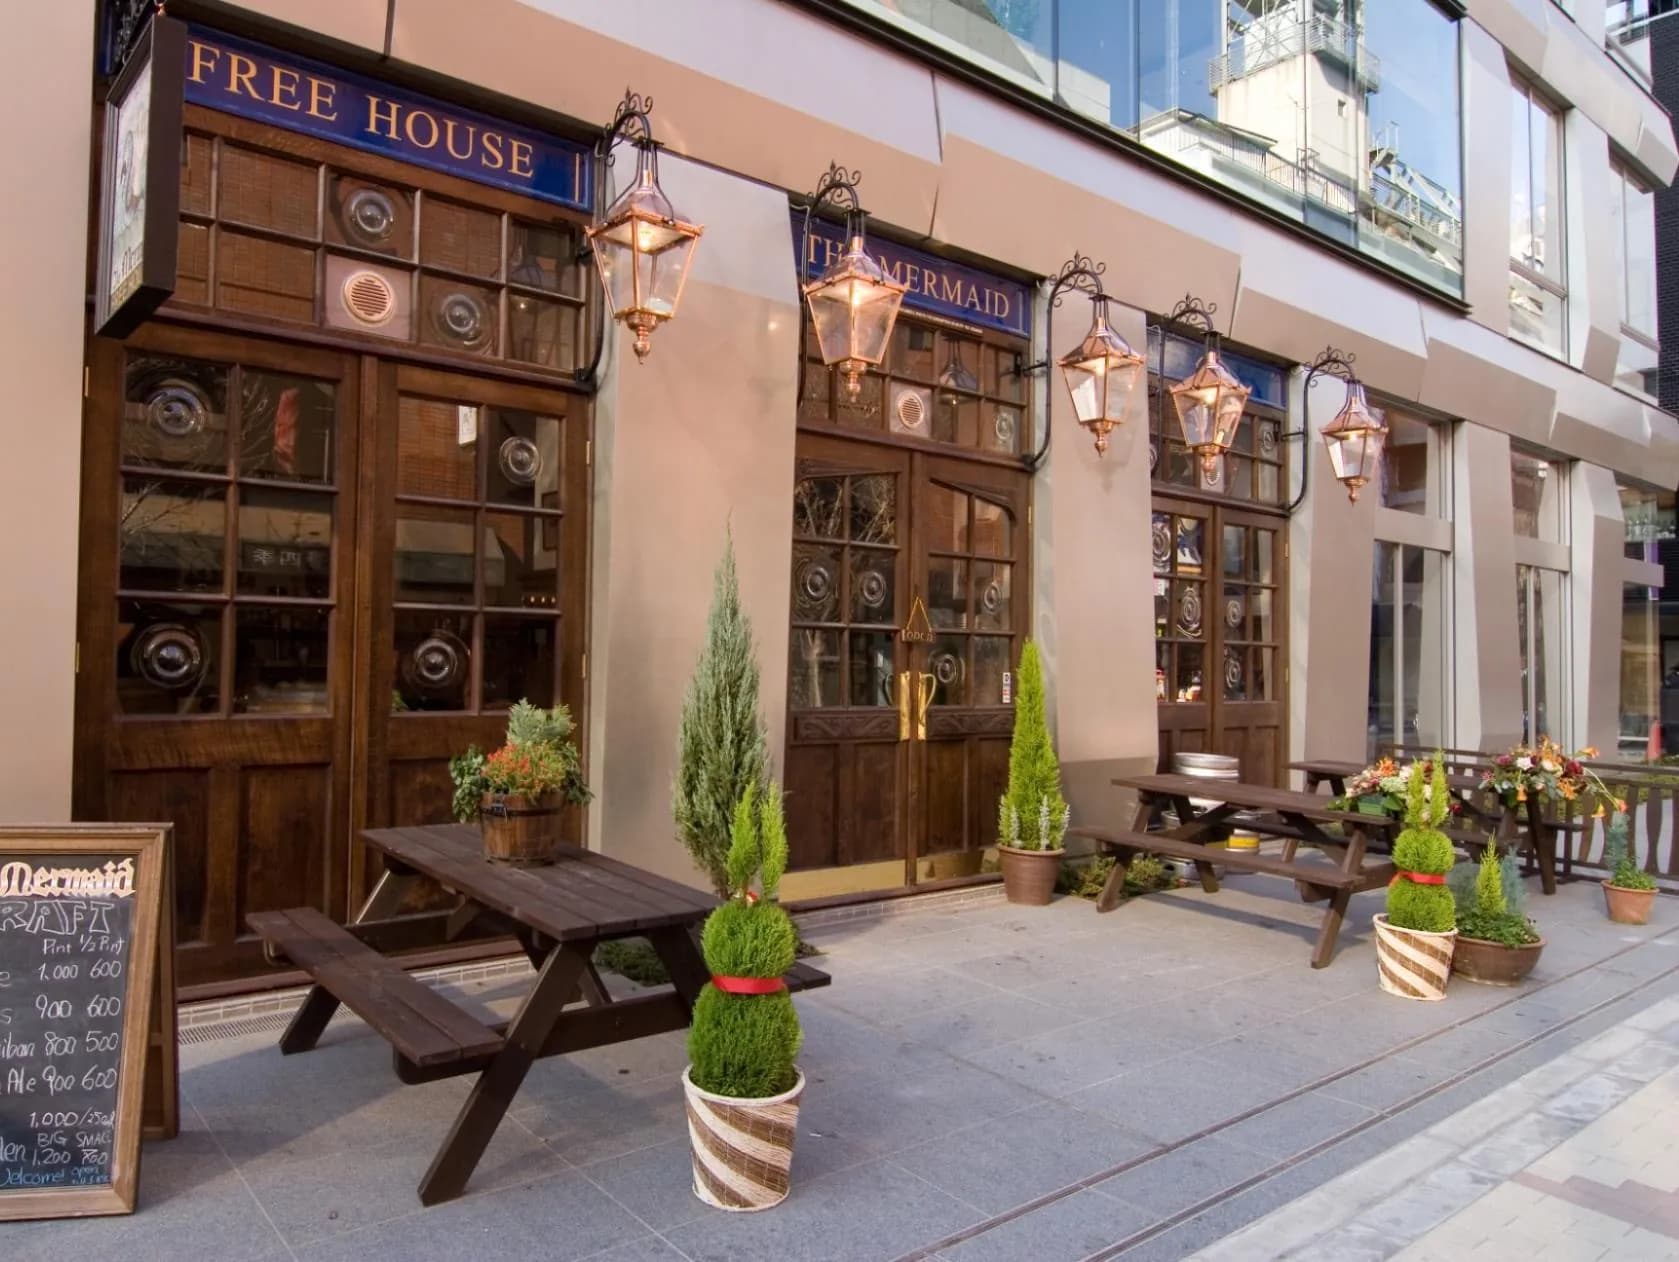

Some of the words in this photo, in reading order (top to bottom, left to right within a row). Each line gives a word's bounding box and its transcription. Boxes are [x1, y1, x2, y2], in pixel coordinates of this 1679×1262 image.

[186, 41, 337, 122] FREE
[364, 94, 534, 178] HOUSE
[808, 233, 847, 269] TH
[878, 255, 1009, 319] MERMAID
[0, 858, 136, 897] Mermaid
[42, 938, 72, 955] Pint
[90, 958, 121, 978] 600
[35, 994, 72, 1019] 900
[87, 994, 121, 1018] 600
[0, 1031, 35, 1060] iban
[44, 1031, 77, 1057] 800
[86, 1030, 119, 1053] 500
[7, 1066, 37, 1095] Ale
[42, 1065, 76, 1096] 900
[81, 1064, 118, 1091] 600
[37, 1130, 67, 1148] BIG
[82, 1148, 109, 1166] 700
